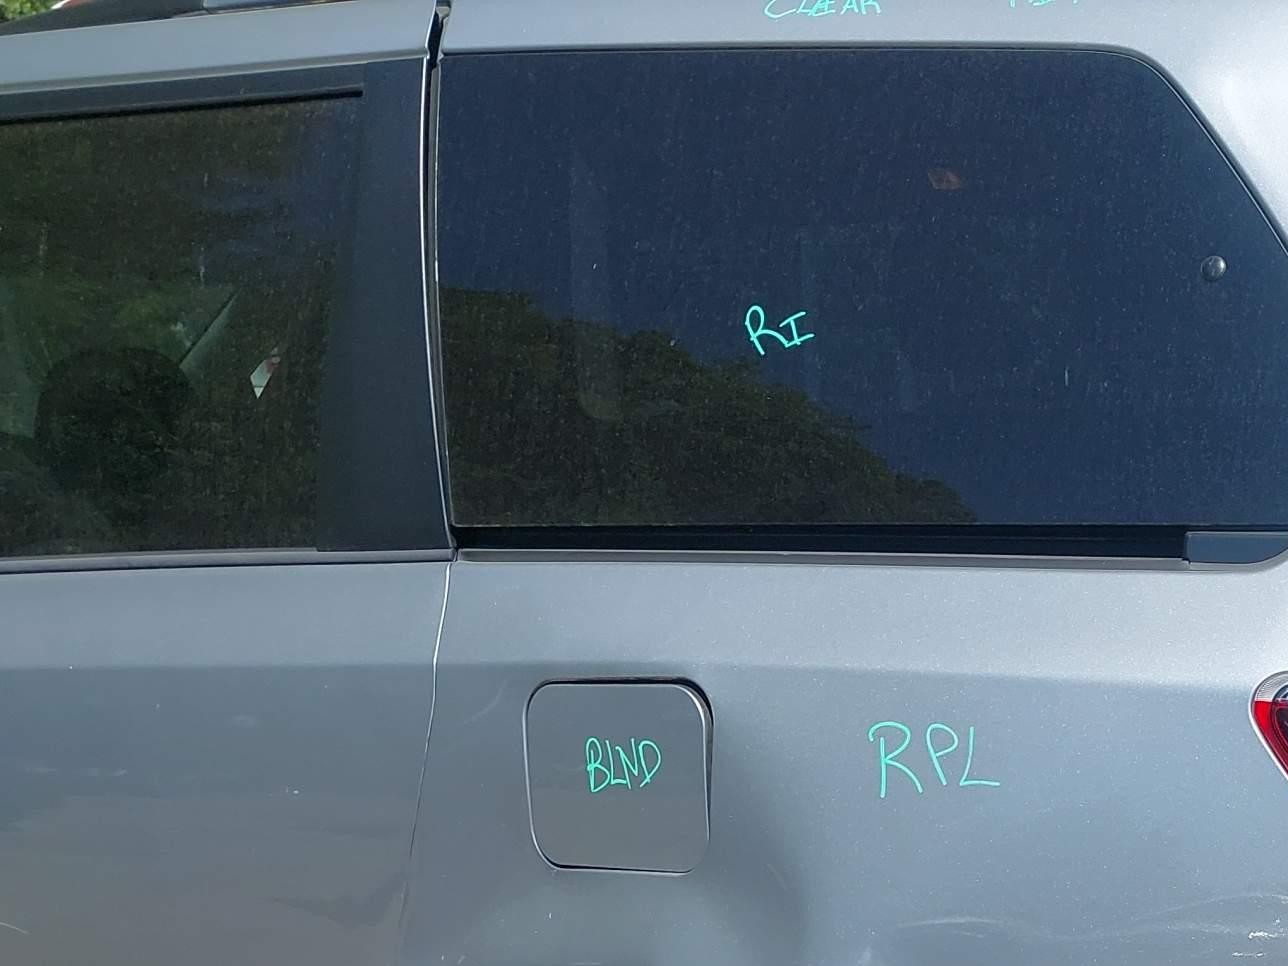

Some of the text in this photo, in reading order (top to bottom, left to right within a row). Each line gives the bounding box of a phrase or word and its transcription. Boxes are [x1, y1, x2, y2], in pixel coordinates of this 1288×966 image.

[744, 305, 815, 356] RI
[584, 736, 662, 793] BLND
[866, 720, 1001, 798] RPL
